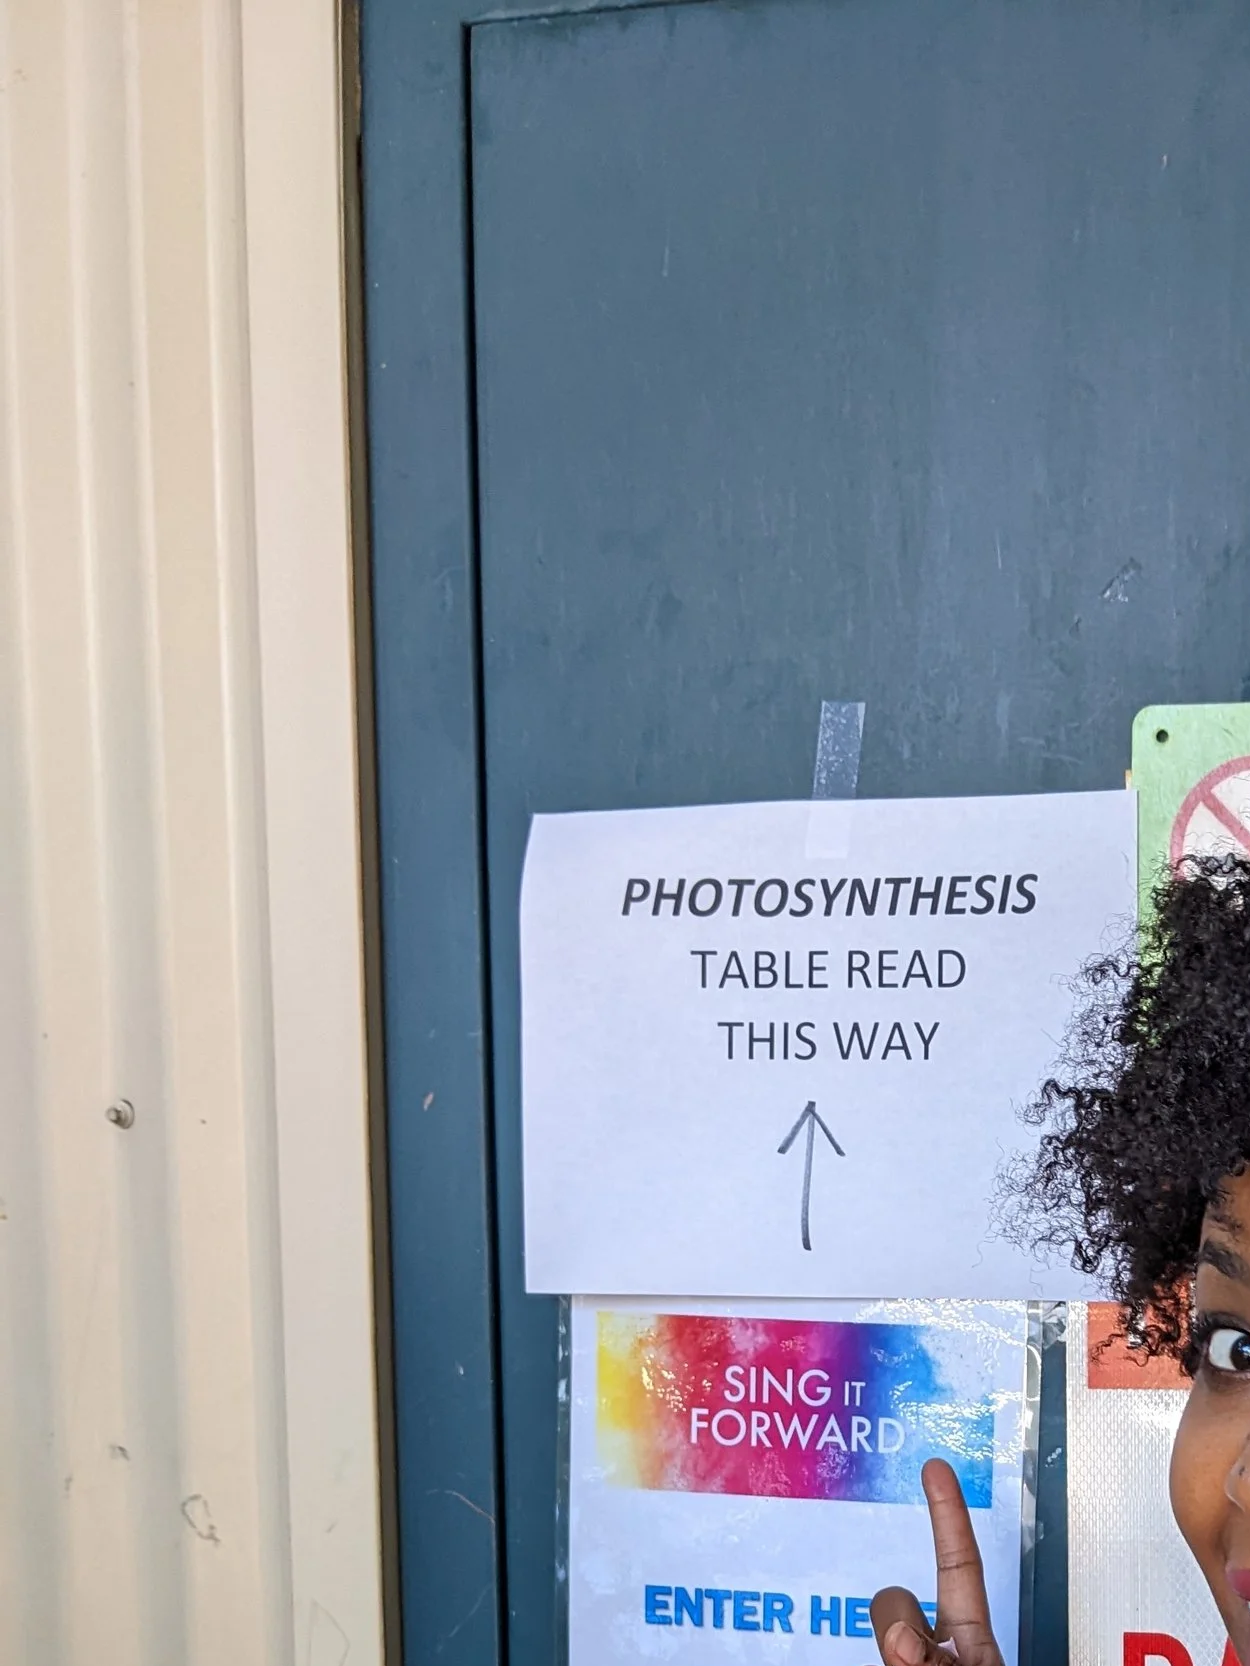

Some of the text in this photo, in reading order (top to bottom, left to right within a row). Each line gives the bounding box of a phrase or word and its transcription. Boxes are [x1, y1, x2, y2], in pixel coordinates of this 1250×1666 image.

[622, 873, 1039, 918] PHOTOSYNTHESIS
[690, 949, 966, 989] TABLE READ
[717, 1021, 940, 1061] THIS WAY
[724, 1365, 866, 1406] SING IT
[690, 1408, 906, 1454] FORWARD
[644, 1585, 794, 1633] ENTER
